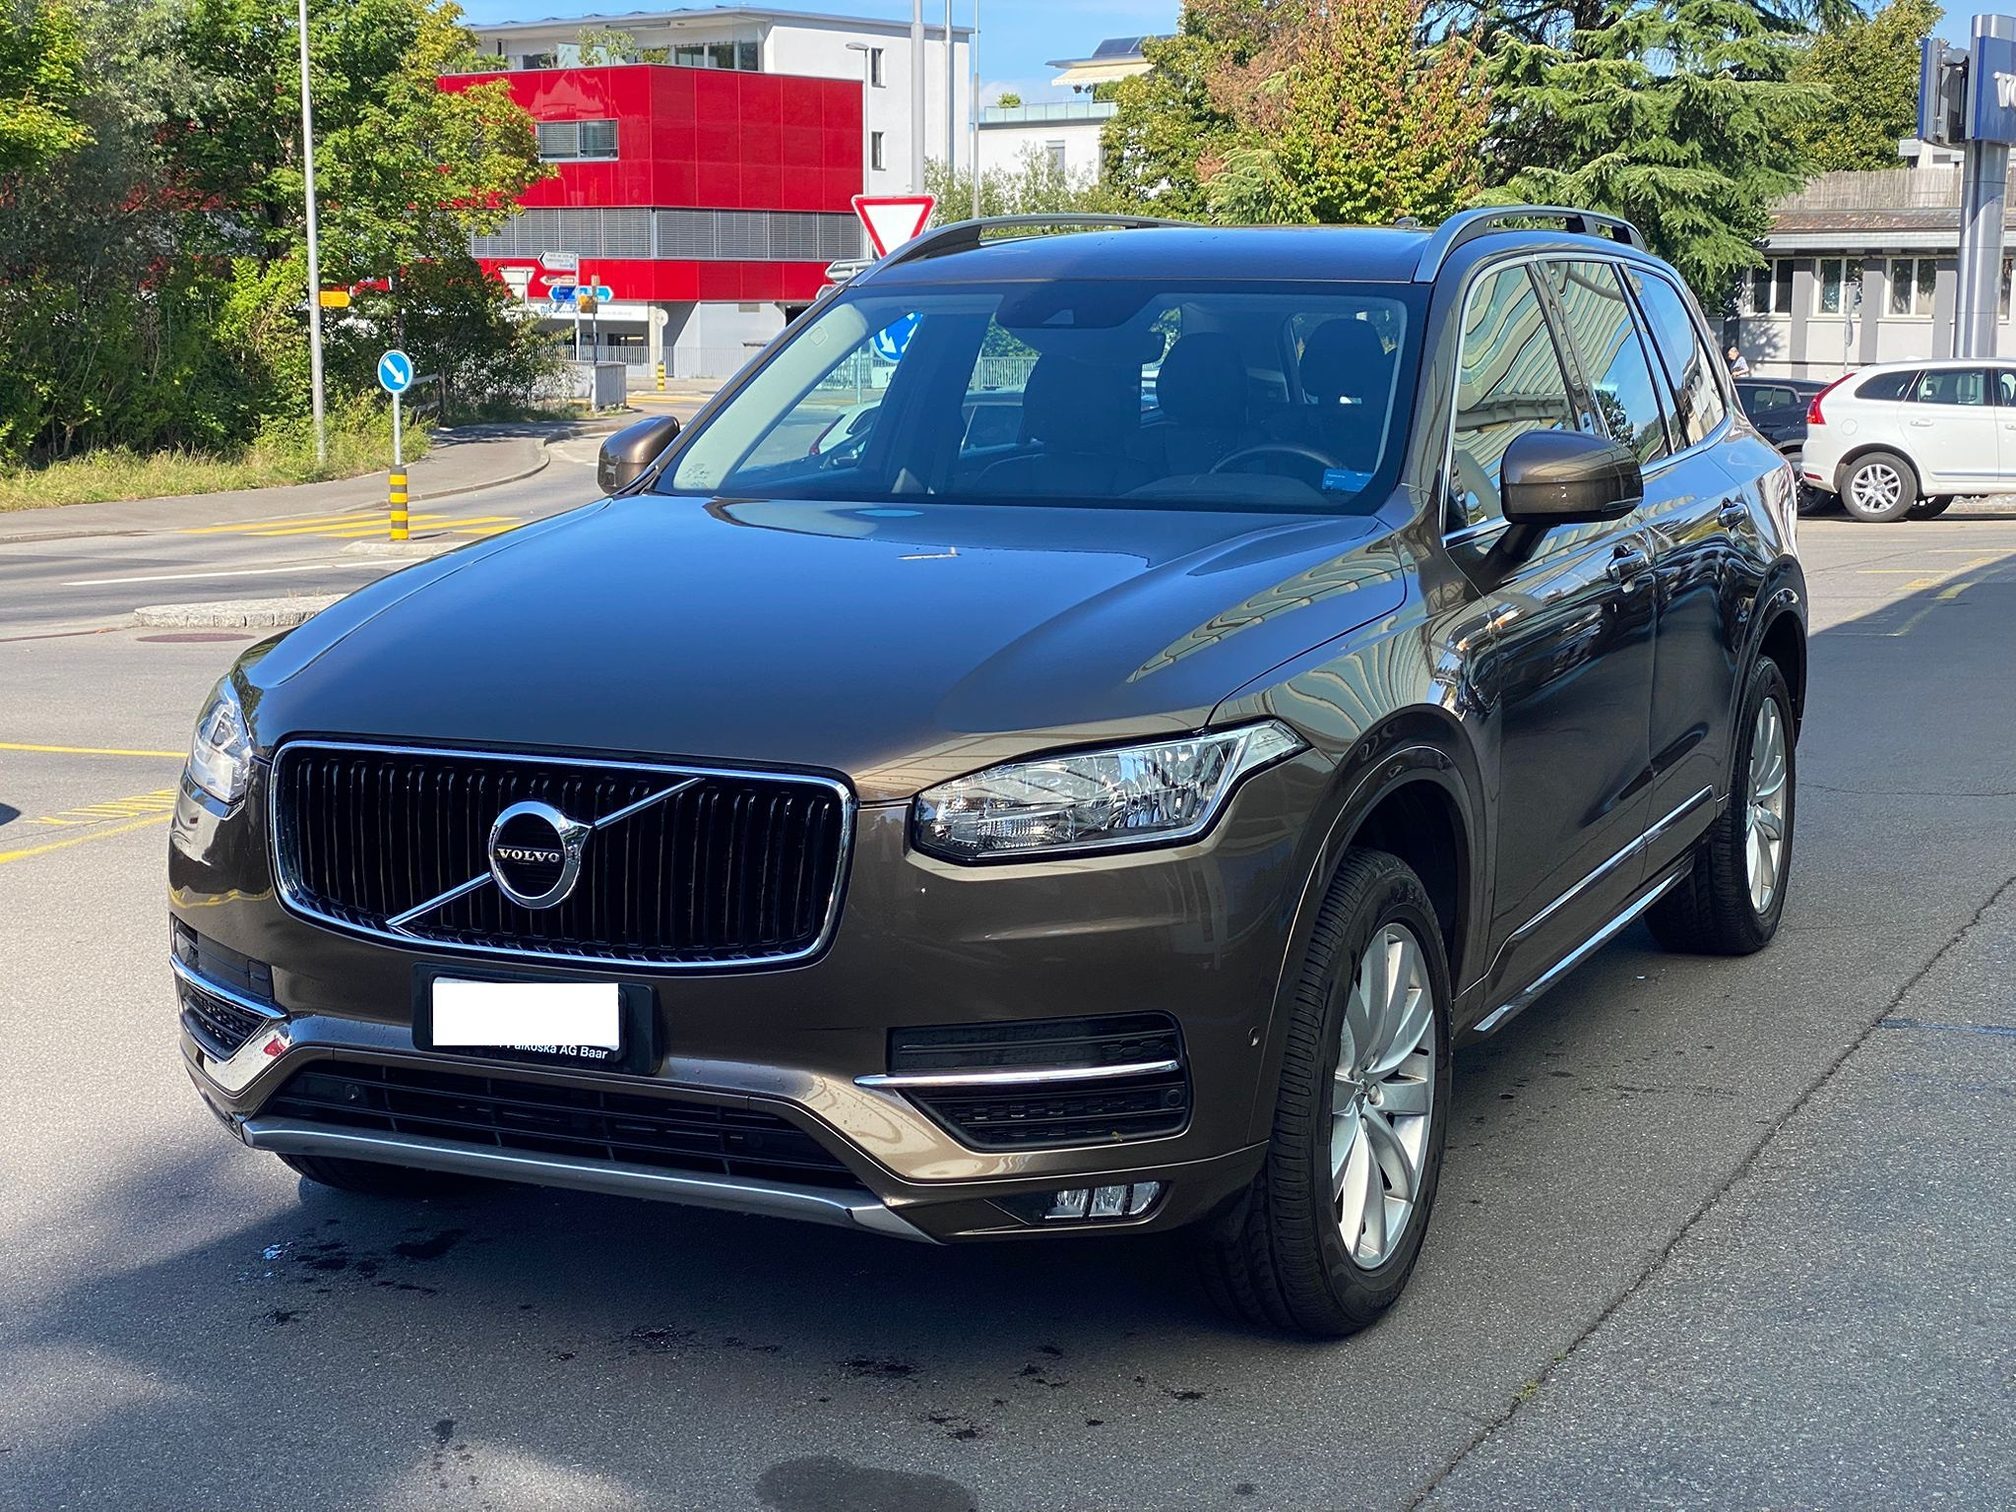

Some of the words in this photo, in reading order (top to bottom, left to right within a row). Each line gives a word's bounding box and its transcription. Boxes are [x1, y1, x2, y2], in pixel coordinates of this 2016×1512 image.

[1993, 71, 2016, 108] V
[497, 848, 560, 863] VOLVO
[506, 1045, 557, 1054] alkoska
[559, 1045, 577, 1056] AG
[580, 1046, 608, 1060] Baar
